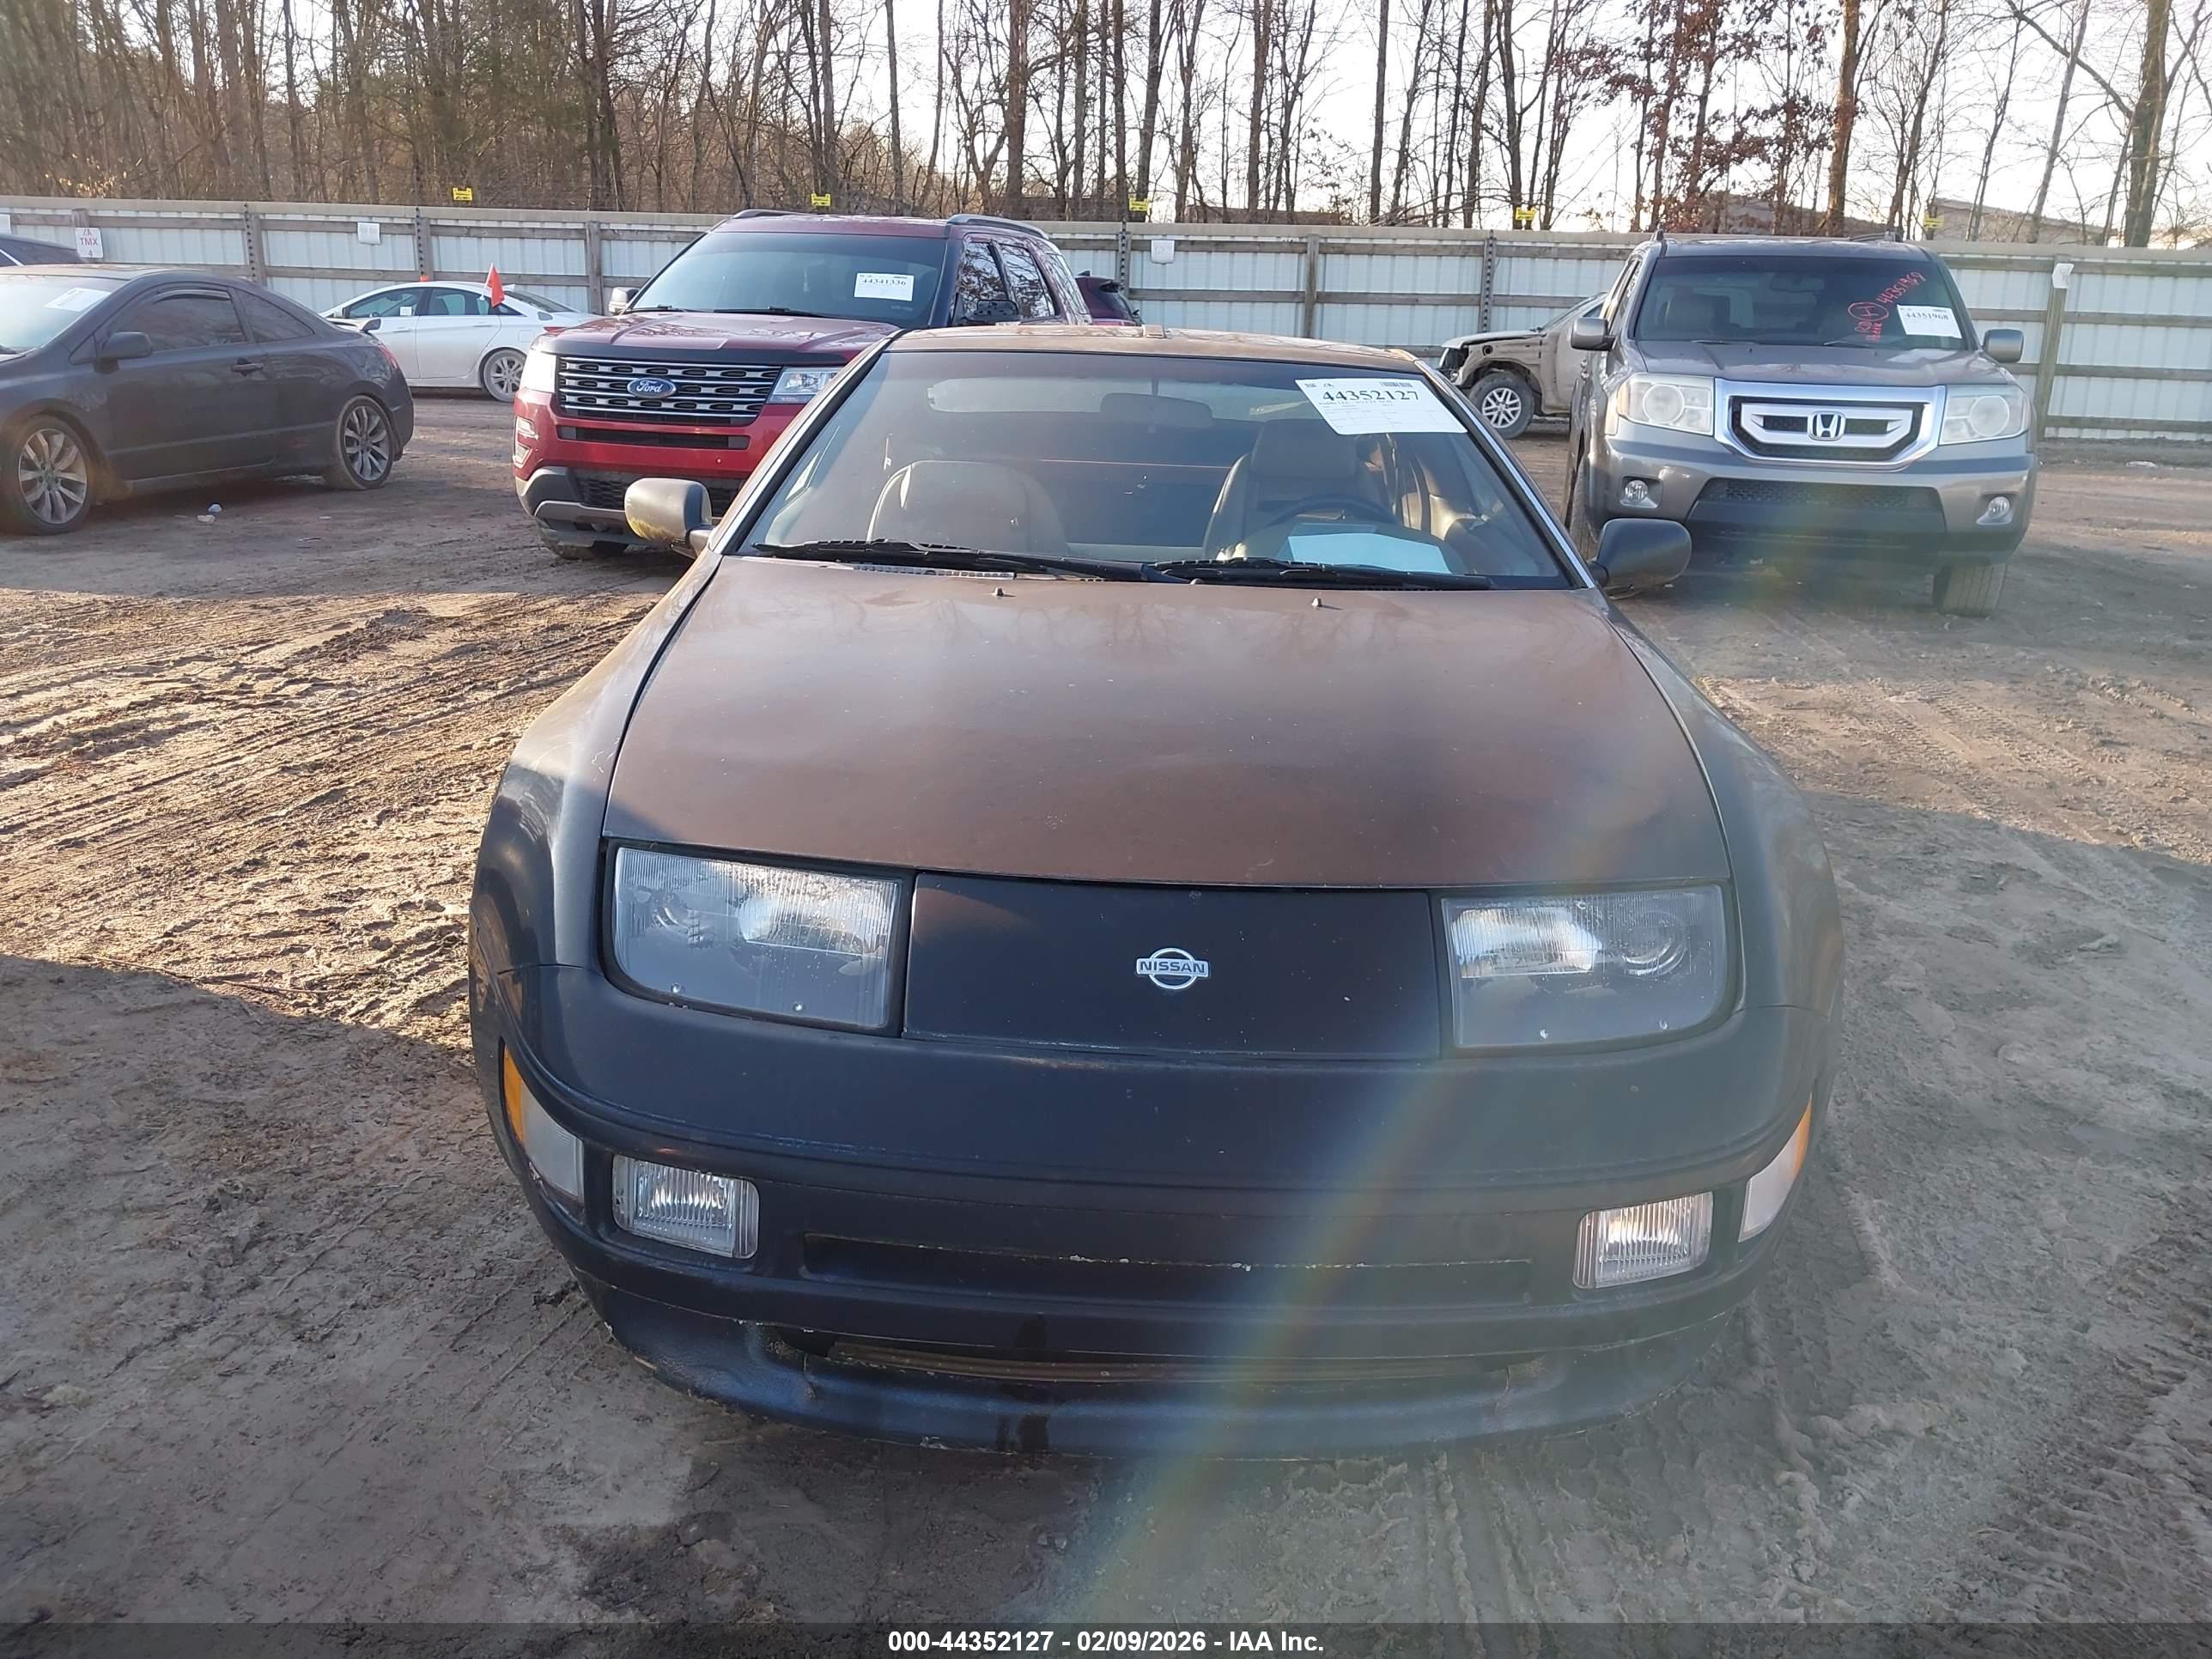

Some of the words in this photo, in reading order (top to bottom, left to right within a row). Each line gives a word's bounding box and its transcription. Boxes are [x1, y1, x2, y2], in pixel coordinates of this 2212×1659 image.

[79, 237, 98, 246] TMX
[636, 380, 664, 392] Ford
[1322, 390, 1419, 401] 44352127
[1139, 961, 1206, 973] NISSAN
